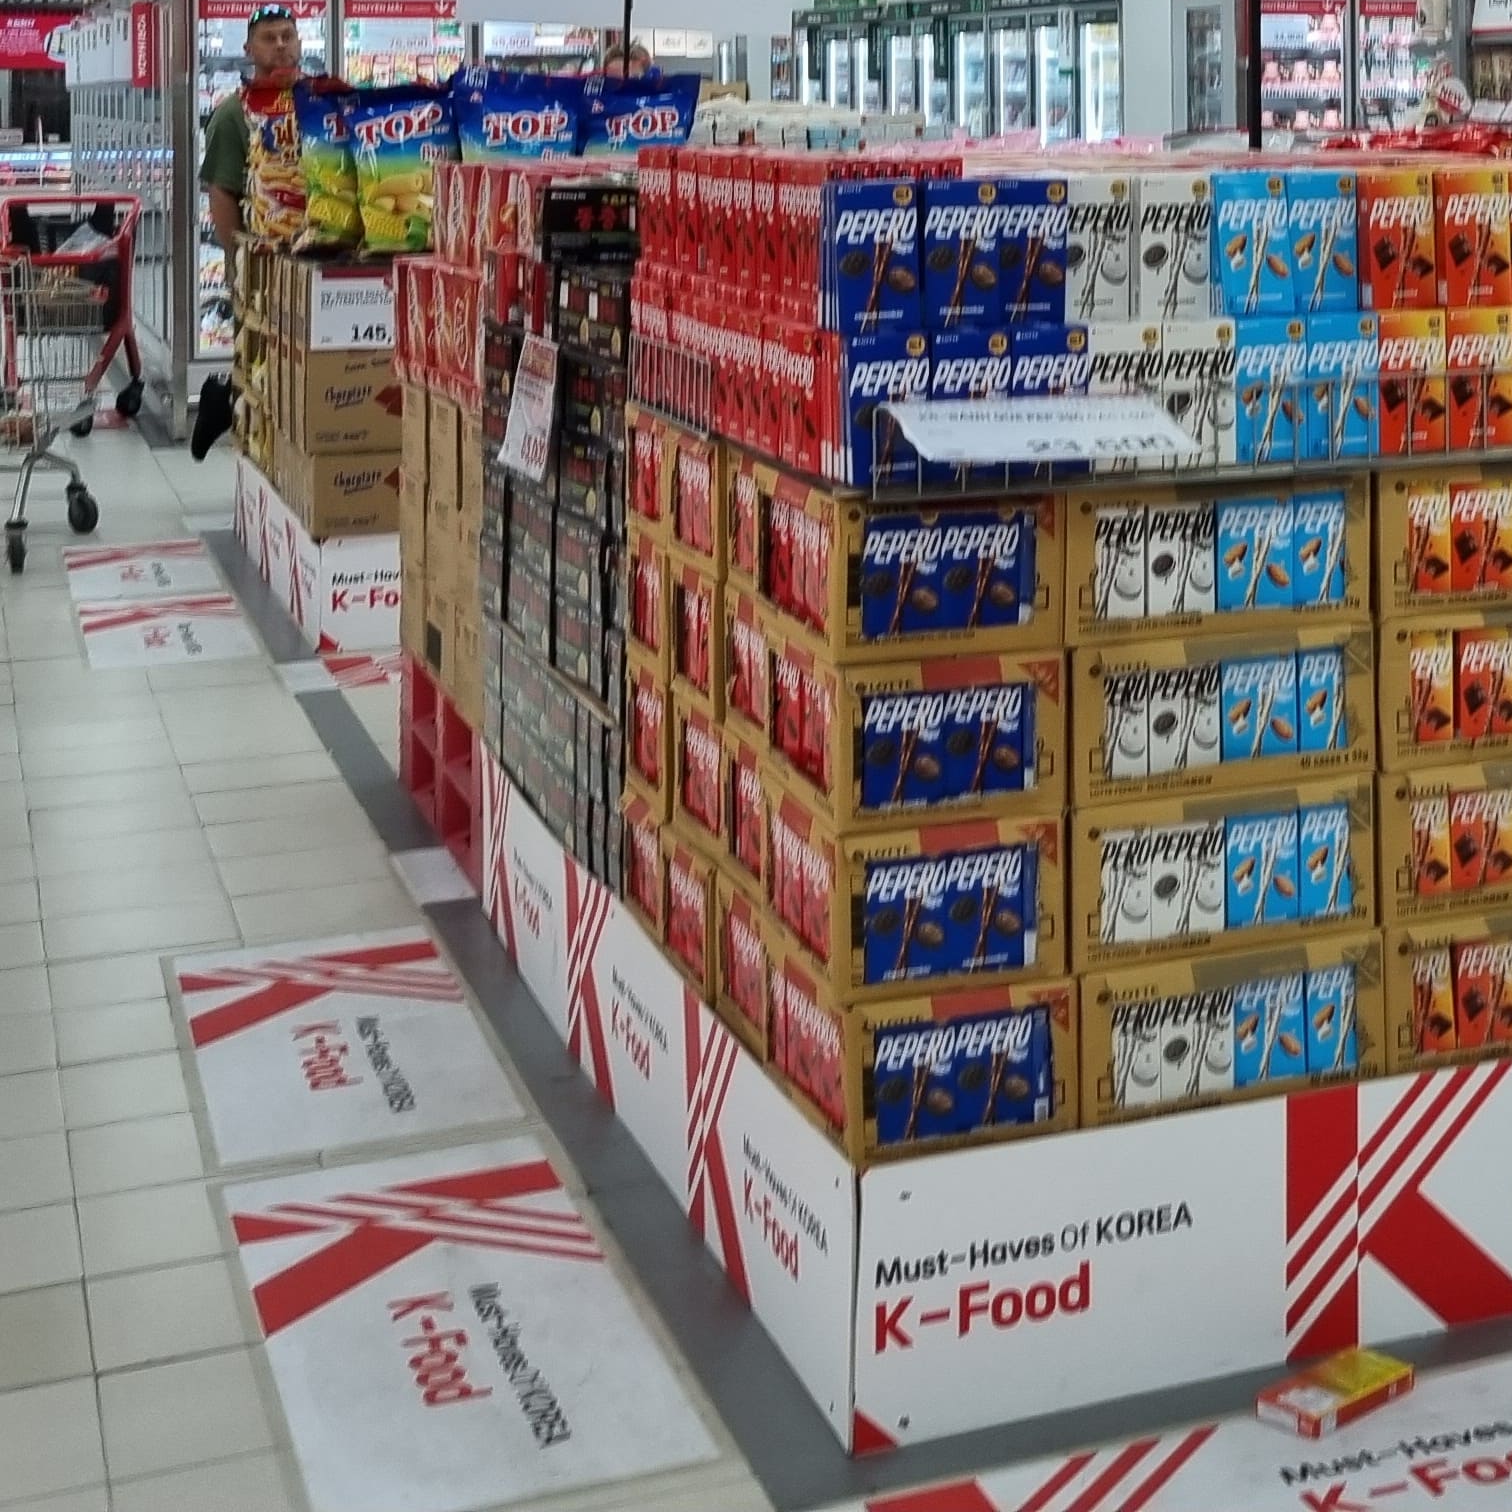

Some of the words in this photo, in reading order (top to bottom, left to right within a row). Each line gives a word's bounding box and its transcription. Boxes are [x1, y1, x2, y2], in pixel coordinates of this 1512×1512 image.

[356, 103, 443, 149] TOP
[483, 109, 568, 146] TOP
[606, 107, 680, 141] TOP
[836, 208, 917, 246] PEPERO
[1141, 202, 1210, 233] PEPERO
[1288, 197, 1356, 225] PEPERO
[1445, 193, 1509, 226] PEPERO
[1089, 353, 1162, 386] PEPERO
[1237, 344, 1306, 378] PEPERO
[1380, 336, 1446, 371] PEPERO
[932, 355, 1011, 397] PEPERO
[1149, 509, 1214, 542] PEPERO
[862, 529, 943, 564] PEPERO
[864, 692, 944, 732] PEPERO
[1153, 830, 1225, 864] PEPERO
[866, 863, 947, 902] PEPERO
[875, 1030, 957, 1072] PEPERO
[743, 1169, 800, 1284] K-Food
[876, 1234, 1056, 1289] Must-Haves
[1061, 1222, 1091, 1250] Of
[1096, 1201, 1194, 1245] KOREA
[876, 1259, 1092, 1355] K-Food
